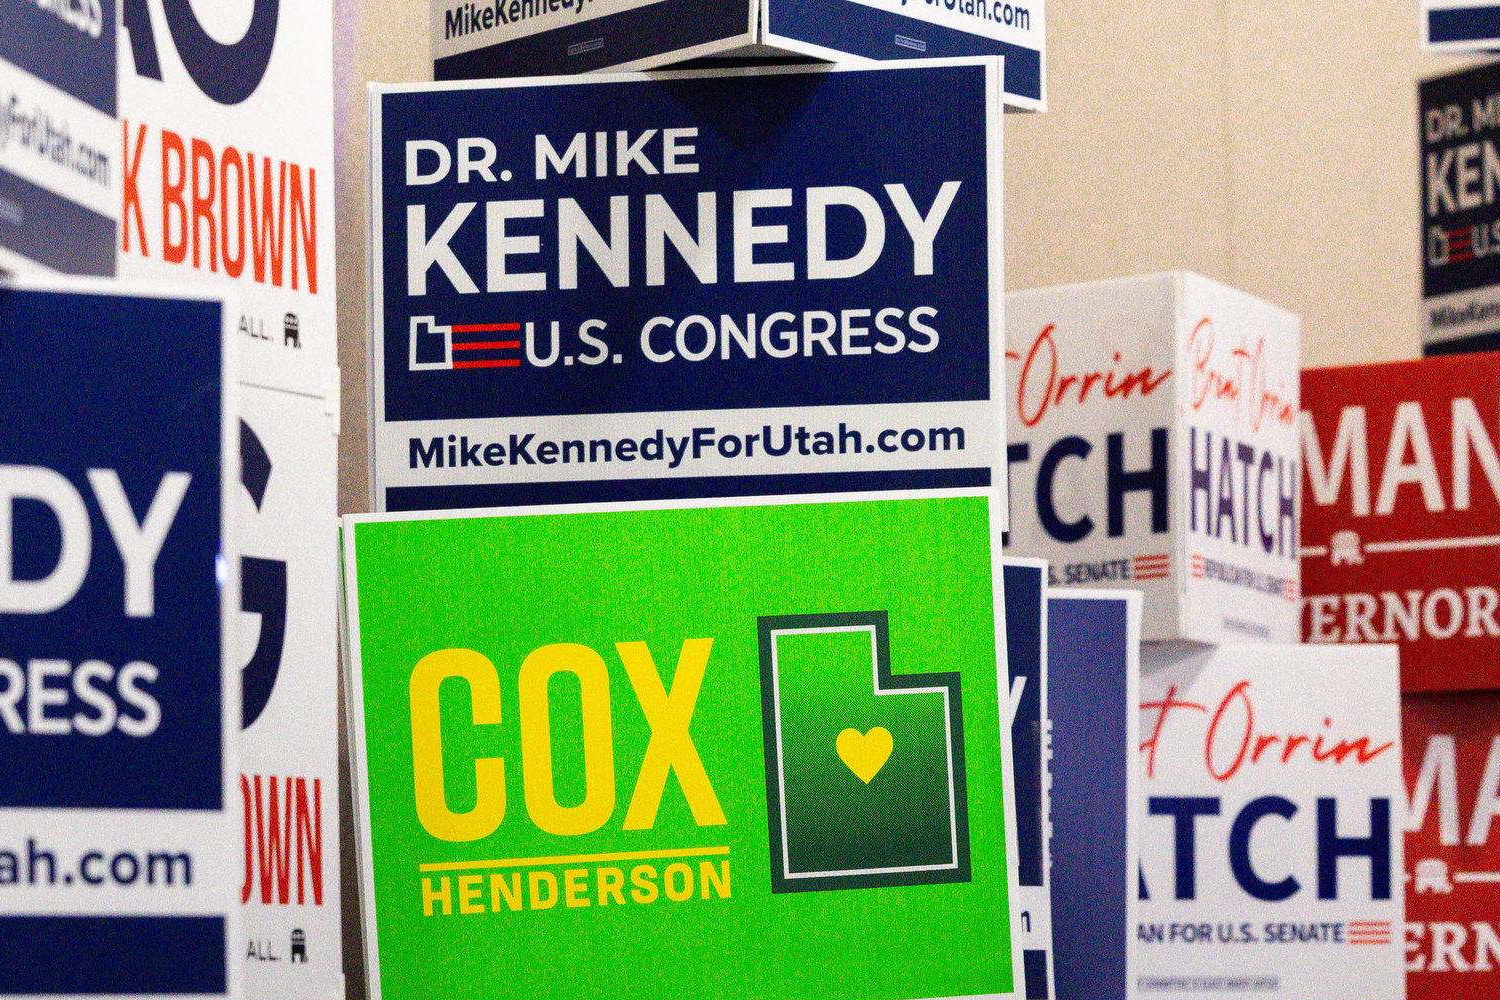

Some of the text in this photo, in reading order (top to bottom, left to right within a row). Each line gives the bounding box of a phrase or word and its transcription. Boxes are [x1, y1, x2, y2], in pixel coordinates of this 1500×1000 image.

[405, 128, 699, 186] DR. MIKE
[161, 128, 318, 295] BROWN
[406, 180, 962, 297] KENNEDY
[237, 314, 275, 341] ALL.
[524, 306, 940, 368] U.S. CONGRESS
[1018, 324, 1172, 426] Orrin
[407, 422, 966, 470] MikeKennedyForUtah.com
[1300, 397, 1500, 517] MAN
[1191, 426, 1296, 560] HATCH
[1064, 558, 1131, 587] SENATE
[1303, 586, 1500, 644] ERNOR
[409, 636, 728, 842] COX
[1206, 680, 1394, 782] Orrin
[421, 860, 731, 917] HENDERSON
[1139, 795, 1393, 902] TCH
[1169, 922, 1214, 944] FOR
[1217, 922, 1260, 944] U.S.
[1263, 921, 1345, 944] SENATE
